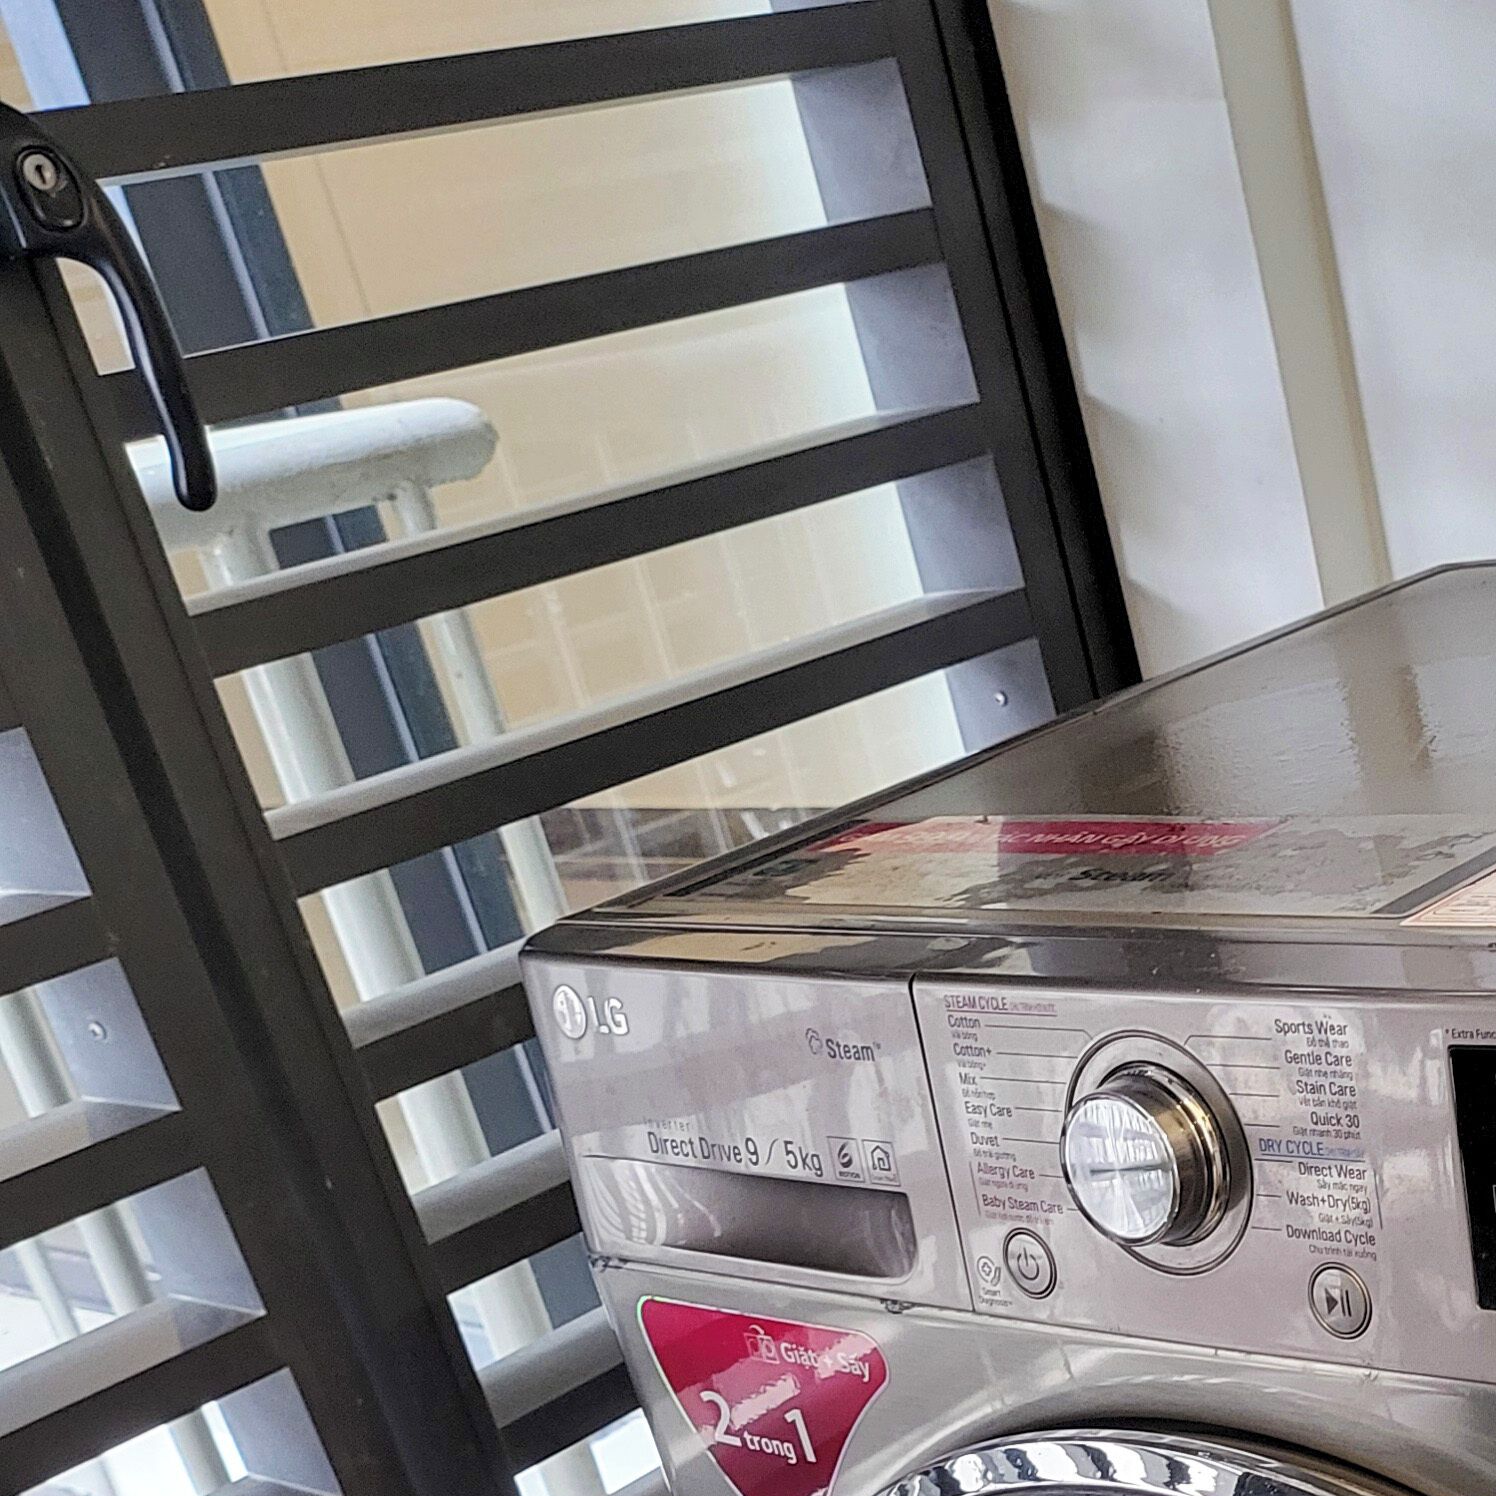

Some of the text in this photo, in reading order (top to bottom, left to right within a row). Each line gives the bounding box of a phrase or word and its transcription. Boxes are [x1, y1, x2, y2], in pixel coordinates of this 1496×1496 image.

[944, 995, 978, 1010] STEAM
[979, 996, 1008, 1011] CYCLE
[587, 996, 629, 1036] LG
[948, 1014, 981, 1028] Cotton
[1274, 1018, 1348, 1037] Sports Wear
[1451, 1028, 1474, 1040] Extra
[953, 1042, 991, 1057] Cotton+
[1284, 1050, 1352, 1067] Gentle Care
[959, 1071, 977, 1086] Mix
[1295, 1080, 1356, 1097] Stain Care
[965, 1100, 1012, 1118] Easy Care
[1310, 1111, 1359, 1128] Quick 30
[648, 1131, 697, 1158] Direct
[699, 1137, 742, 1163] Drive
[970, 1132, 1000, 1147] Duvet
[1258, 1137, 1282, 1152] DRY
[1286, 1140, 1324, 1156] CYCLE
[977, 1162, 1035, 1180] Allergy Care
[1298, 1161, 1367, 1180] Direct Wear
[981, 1193, 1064, 1215] Baby Steam Care
[1286, 1224, 1376, 1247] Download Cycle
[700, 1391, 817, 1465] 2 trong 1
